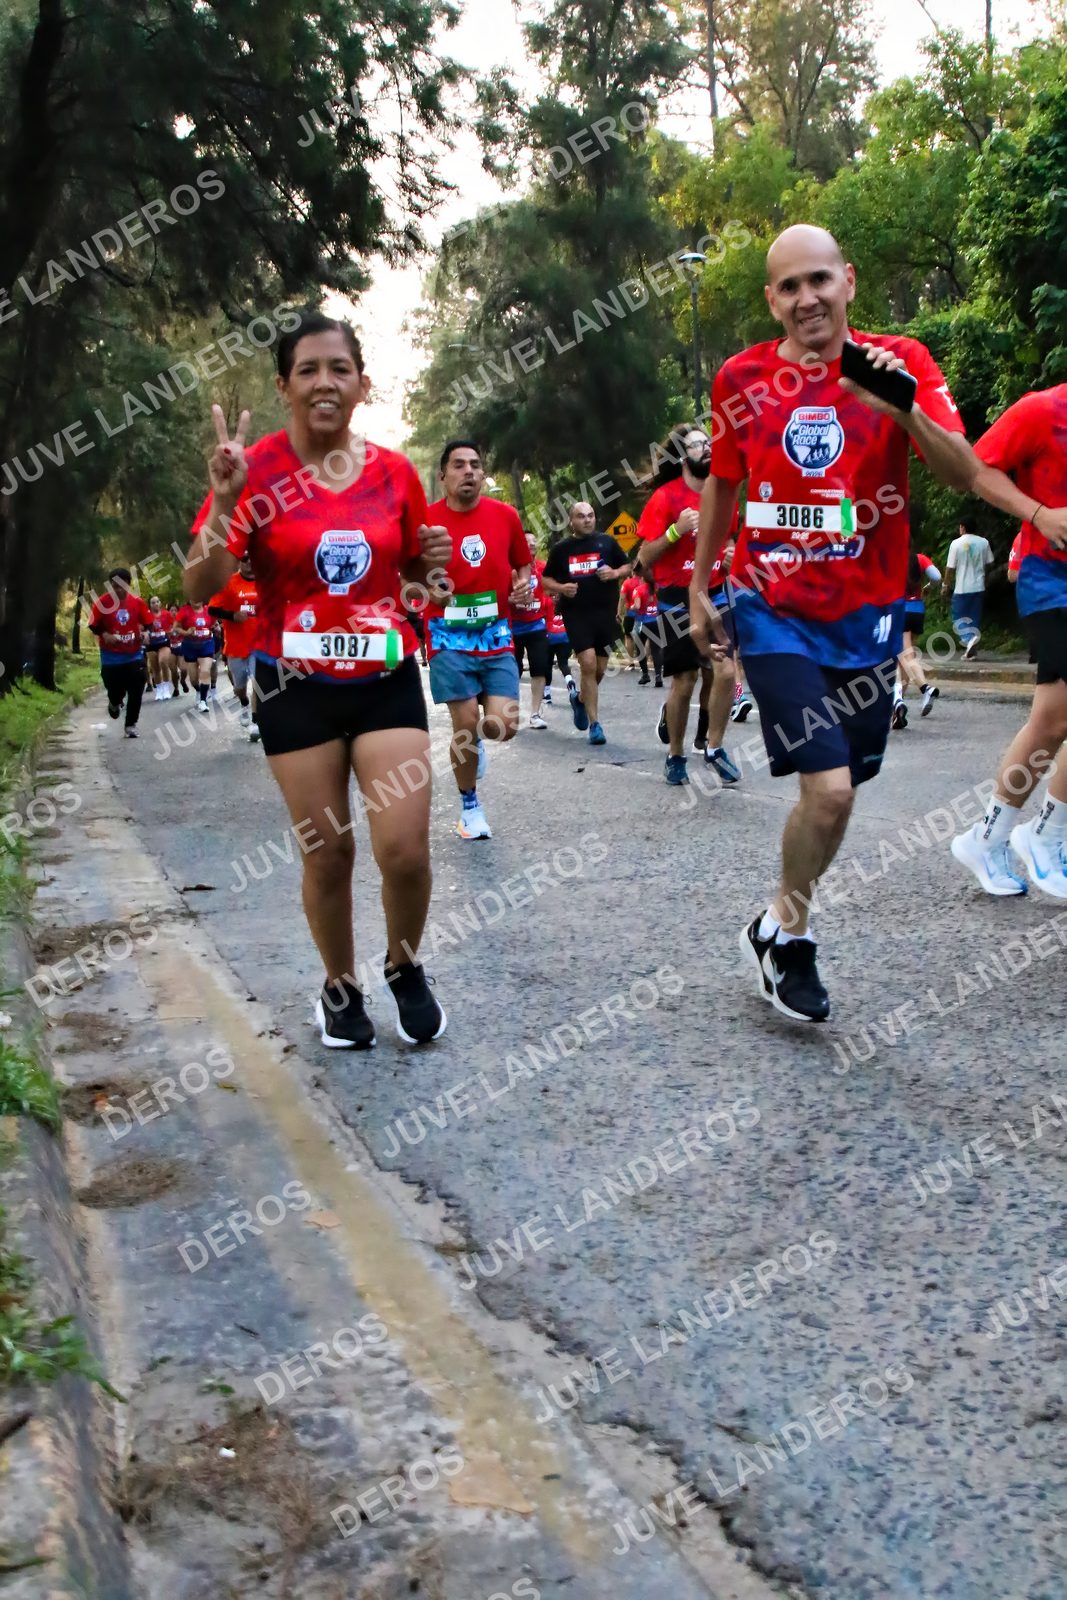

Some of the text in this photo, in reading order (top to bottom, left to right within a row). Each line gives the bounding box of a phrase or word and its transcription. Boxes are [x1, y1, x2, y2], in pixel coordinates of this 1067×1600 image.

[798, 413, 831, 421] BIMBO
[798, 424, 829, 436] Global
[792, 434, 817, 446] Race
[777, 505, 824, 529] 3086
[328, 535, 359, 543] BIMBO
[329, 545, 359, 556] Global
[466, 607, 479, 618] 45
[320, 635, 370, 658] 3087
